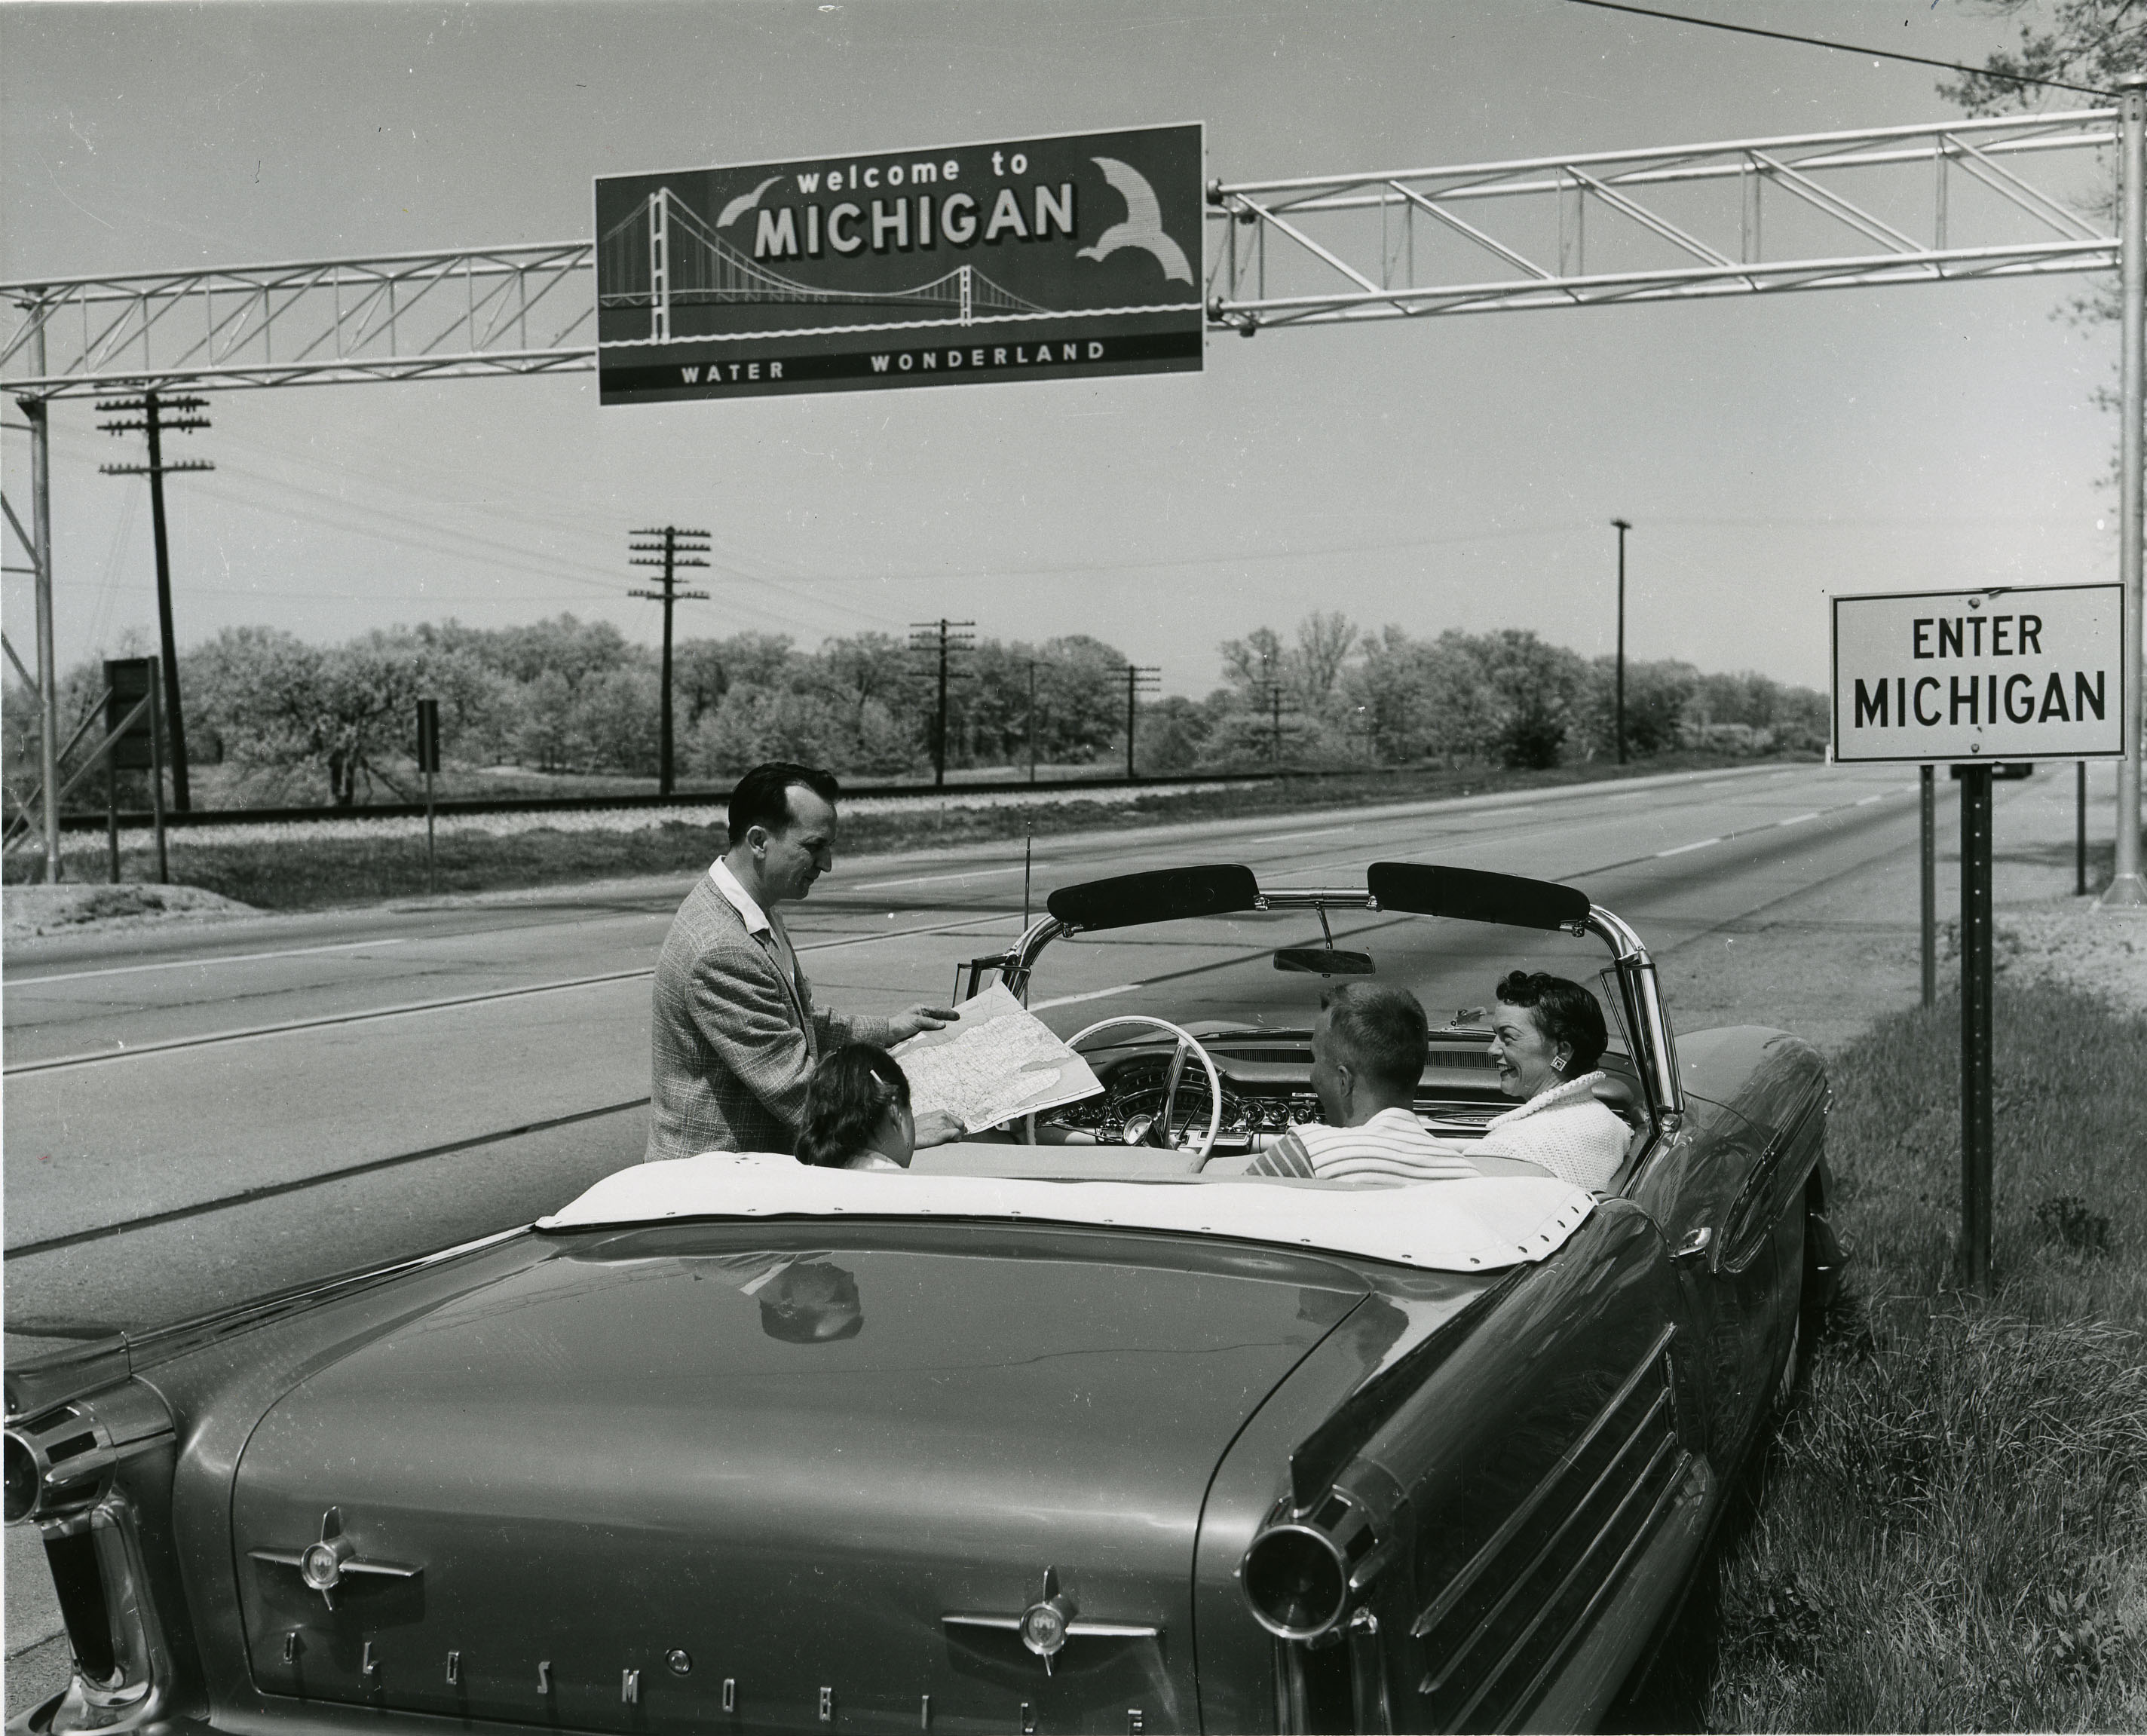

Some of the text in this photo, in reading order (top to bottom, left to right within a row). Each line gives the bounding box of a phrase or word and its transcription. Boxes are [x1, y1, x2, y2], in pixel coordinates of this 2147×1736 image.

[797, 151, 1028, 194] welcome to
[754, 183, 1074, 259] MICHIGAN
[681, 343, 1104, 384] WATER WONDERLAND
[1913, 614, 2043, 660] ENTER
[1854, 670, 2106, 729] MICHIGAN
